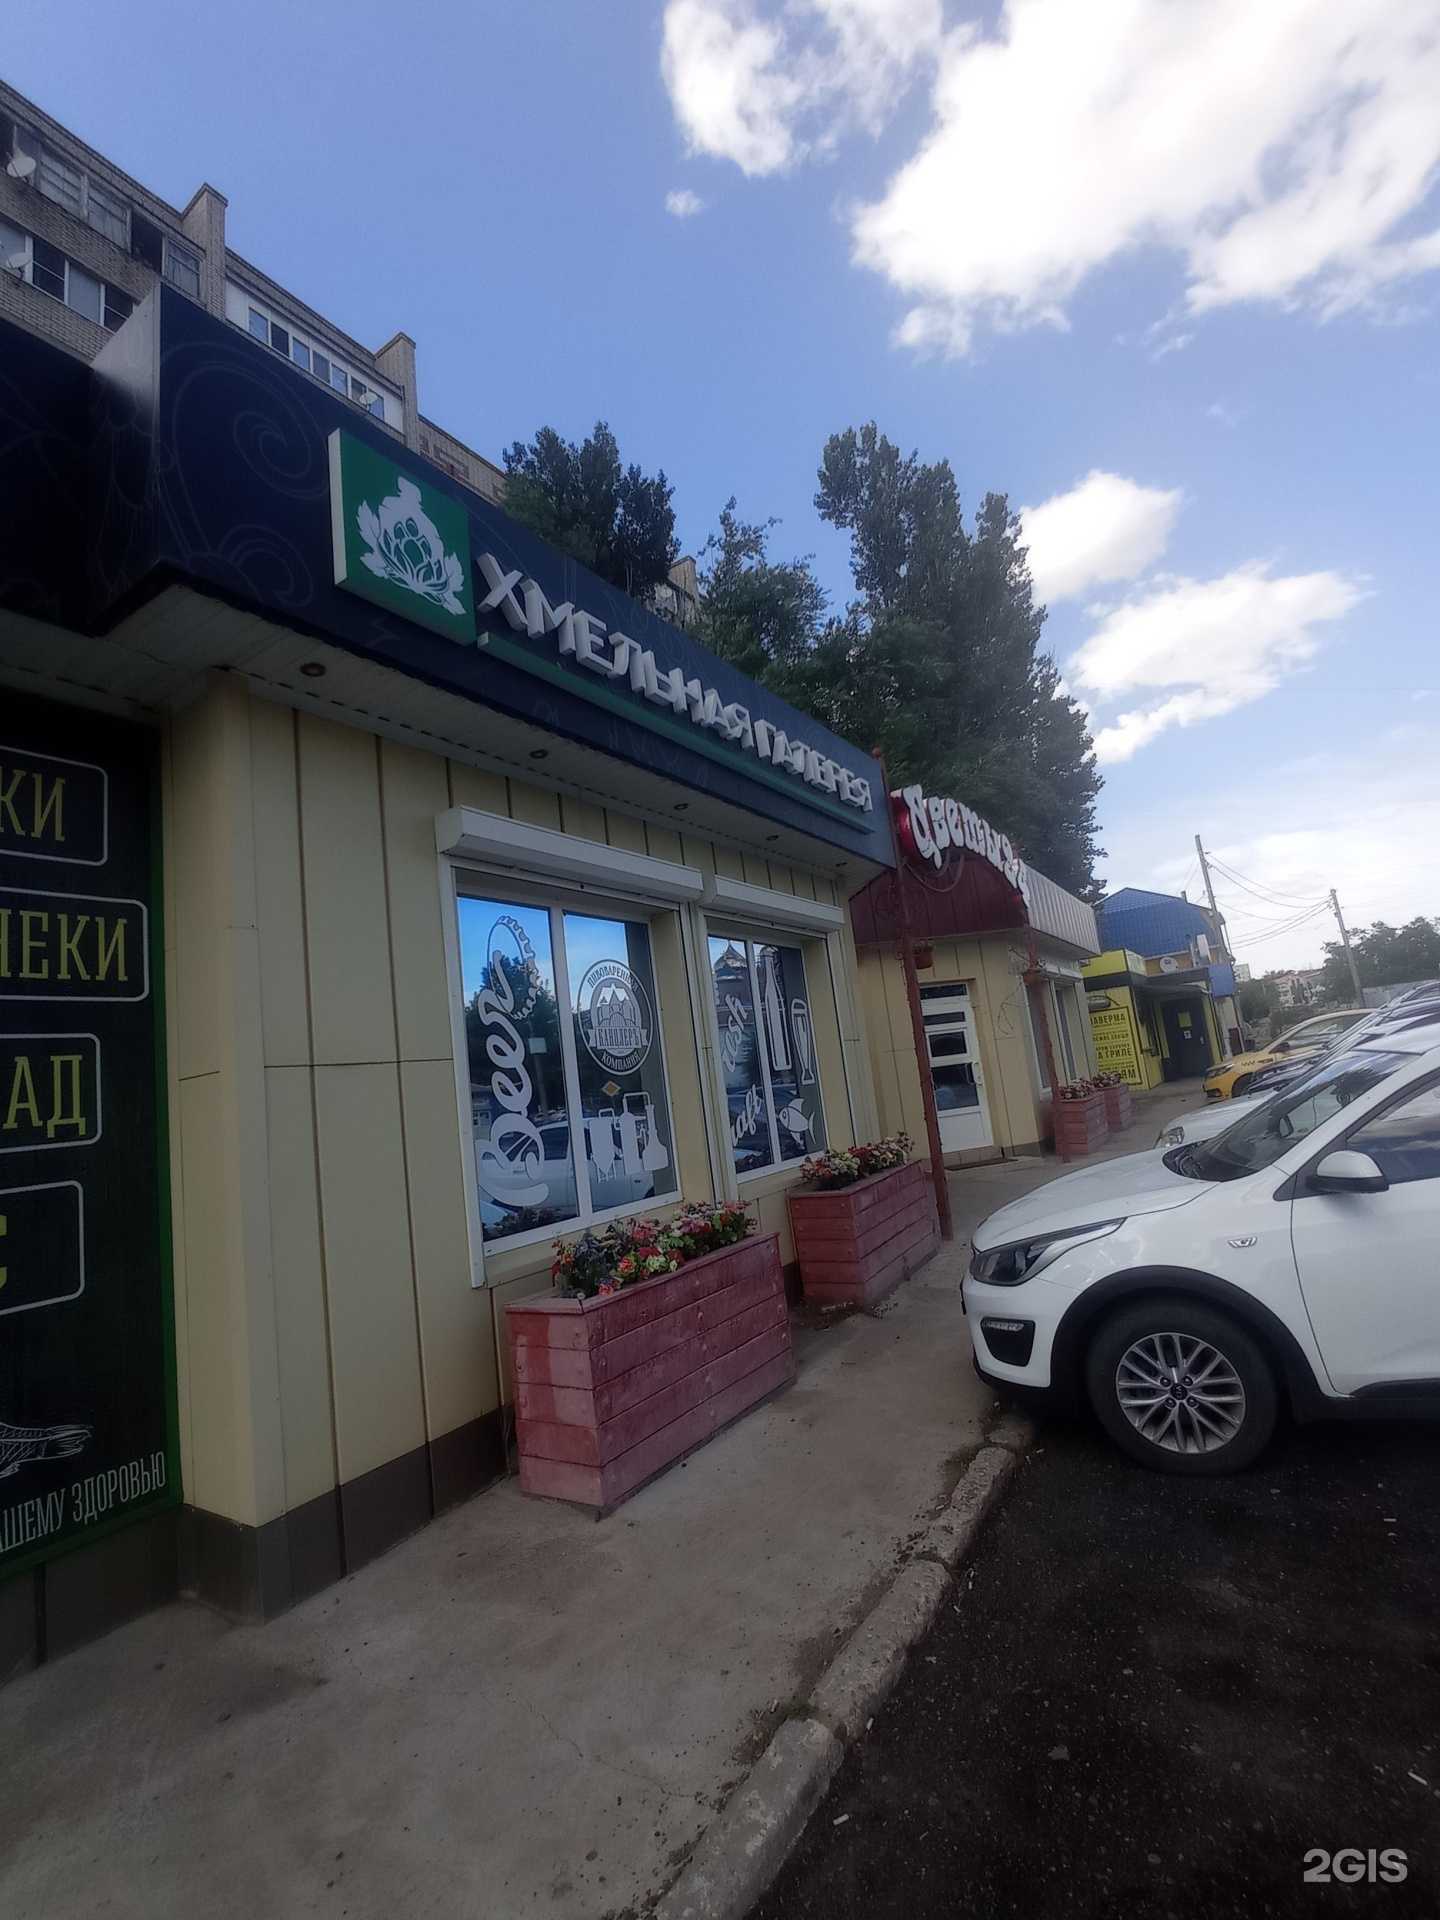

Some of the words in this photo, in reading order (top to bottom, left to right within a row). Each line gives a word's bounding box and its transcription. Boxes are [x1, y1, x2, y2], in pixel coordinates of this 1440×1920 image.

[476, 551, 754, 750] ХМЕЛЬНАЯ
[754, 718, 873, 813] ГАЛЕРЕЯ
[475, 949, 550, 1208] Beer
[0, 1487, 66, 1554] ШЕМУ
[71, 1450, 167, 1525] ЗДОРОВЬЮ
